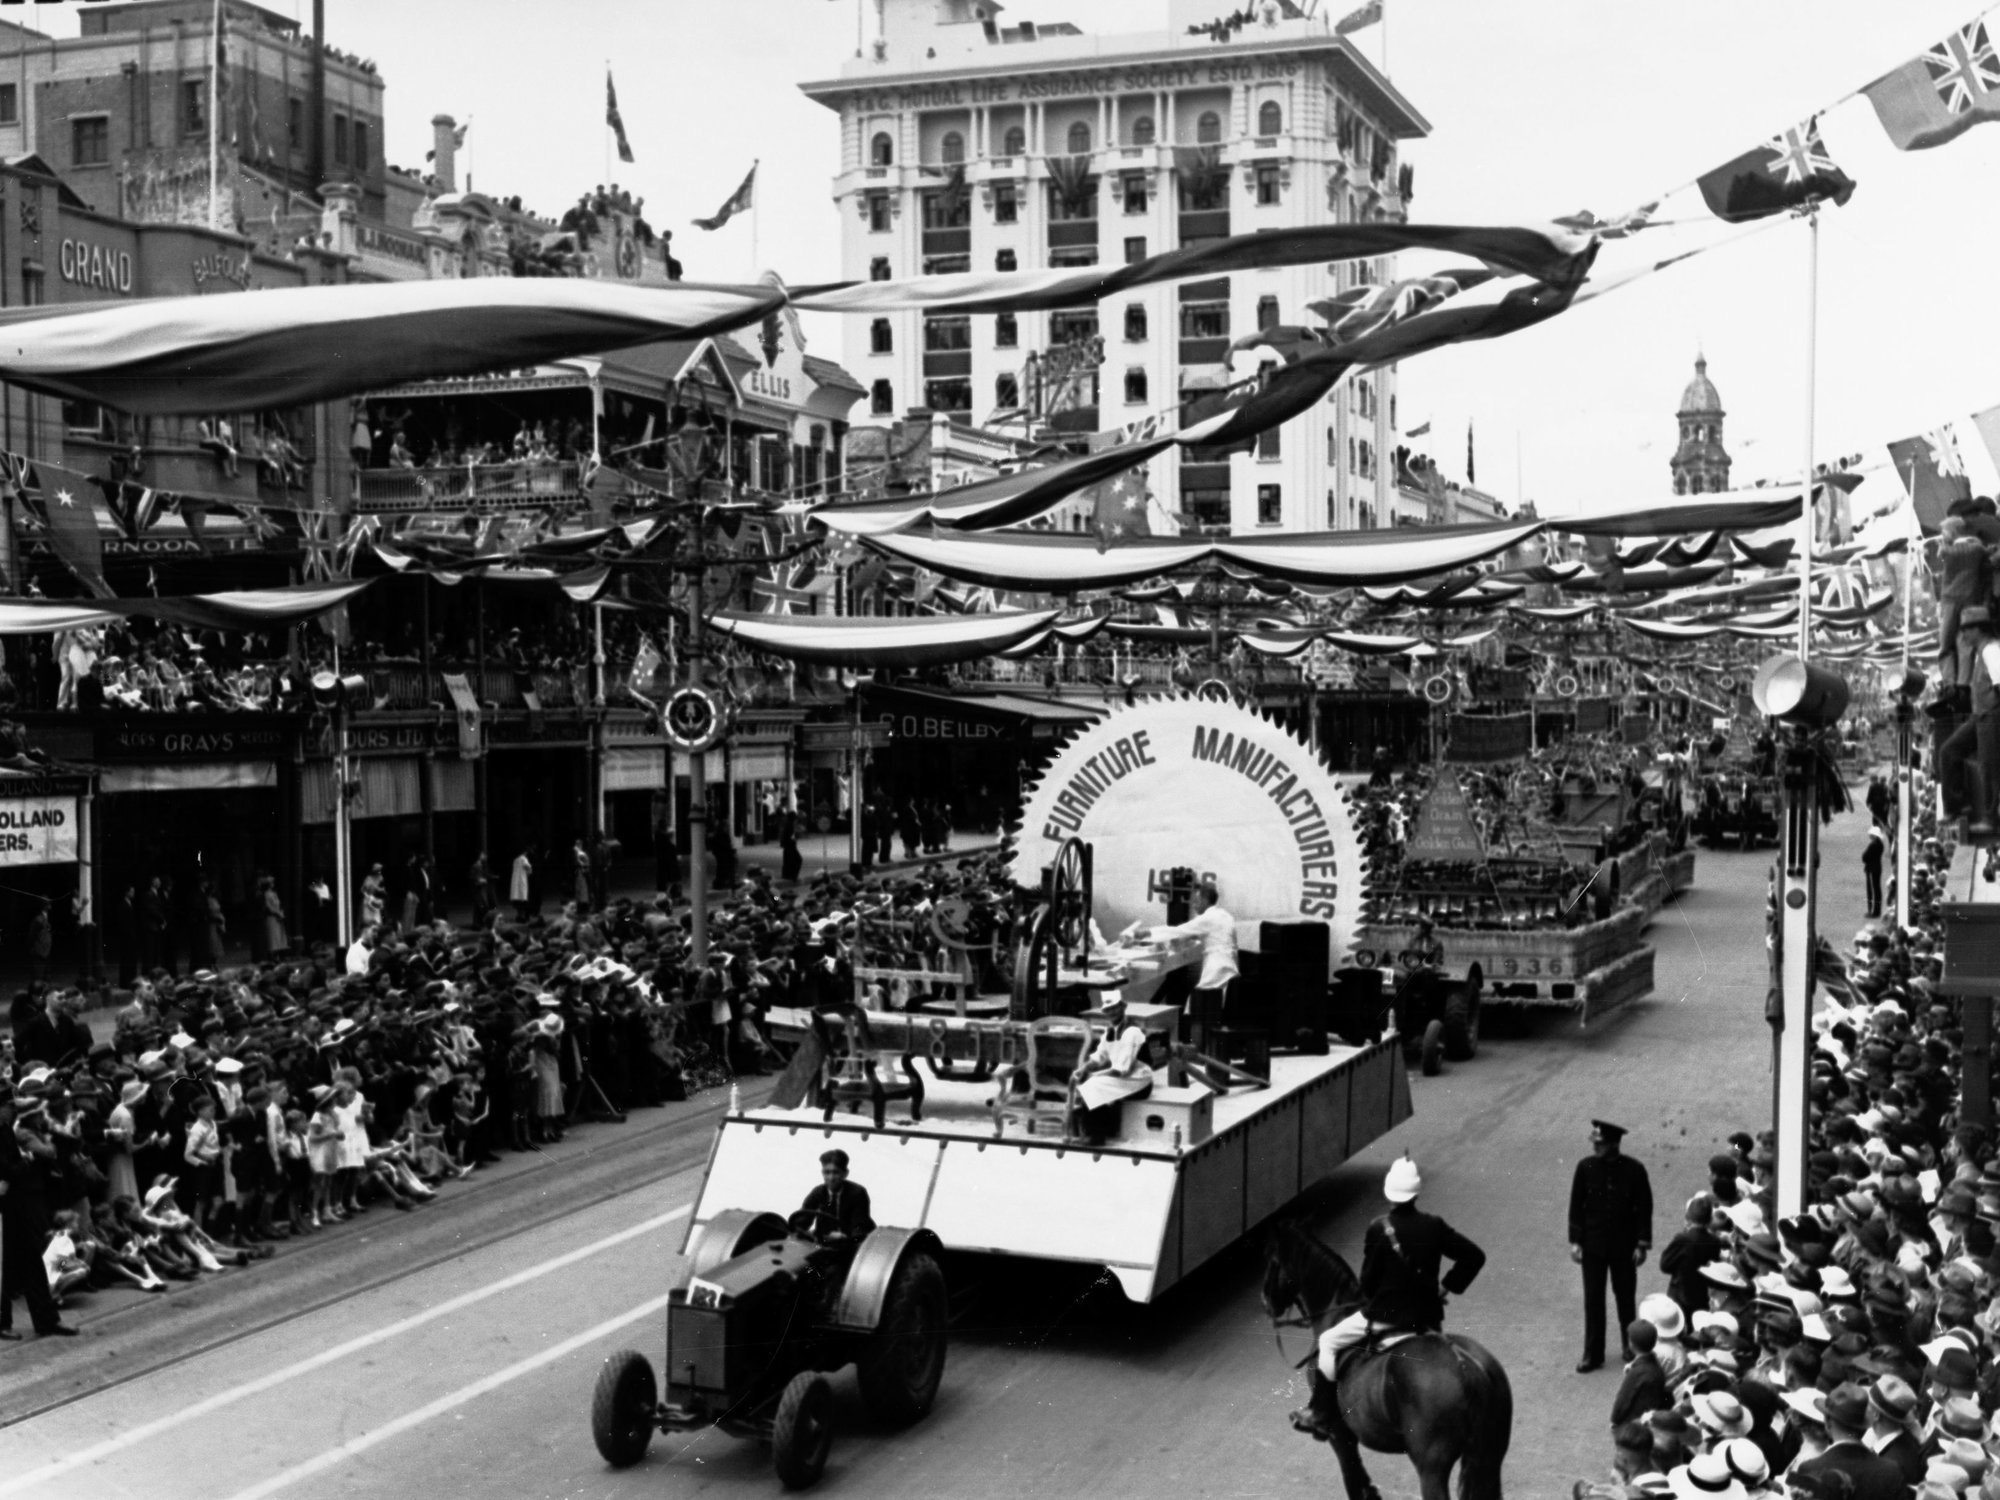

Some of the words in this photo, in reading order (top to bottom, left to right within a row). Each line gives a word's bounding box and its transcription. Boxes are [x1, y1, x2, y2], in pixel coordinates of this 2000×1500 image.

[898, 86, 963, 109] MUTUAL
[970, 81, 1009, 103] LIFE
[1018, 75, 1115, 99] ASSURANCE
[1125, 68, 1197, 90] SOCIETY
[60, 237, 132, 292] GRAND
[751, 370, 791, 399] ELLIS
[30, 539, 202, 554] ARNOON
[227, 537, 264, 551] TE
[164, 732, 234, 752] GRAYS
[396, 729, 425, 746] LTD.
[1042, 729, 1156, 843] FURNITURE
[1191, 725, 1337, 920] MANUFACTURERS
[1415, 835, 1450, 850] Golden
[1486, 958, 1563, 976] 1936
[906, 1015, 1016, 1063] 1836
